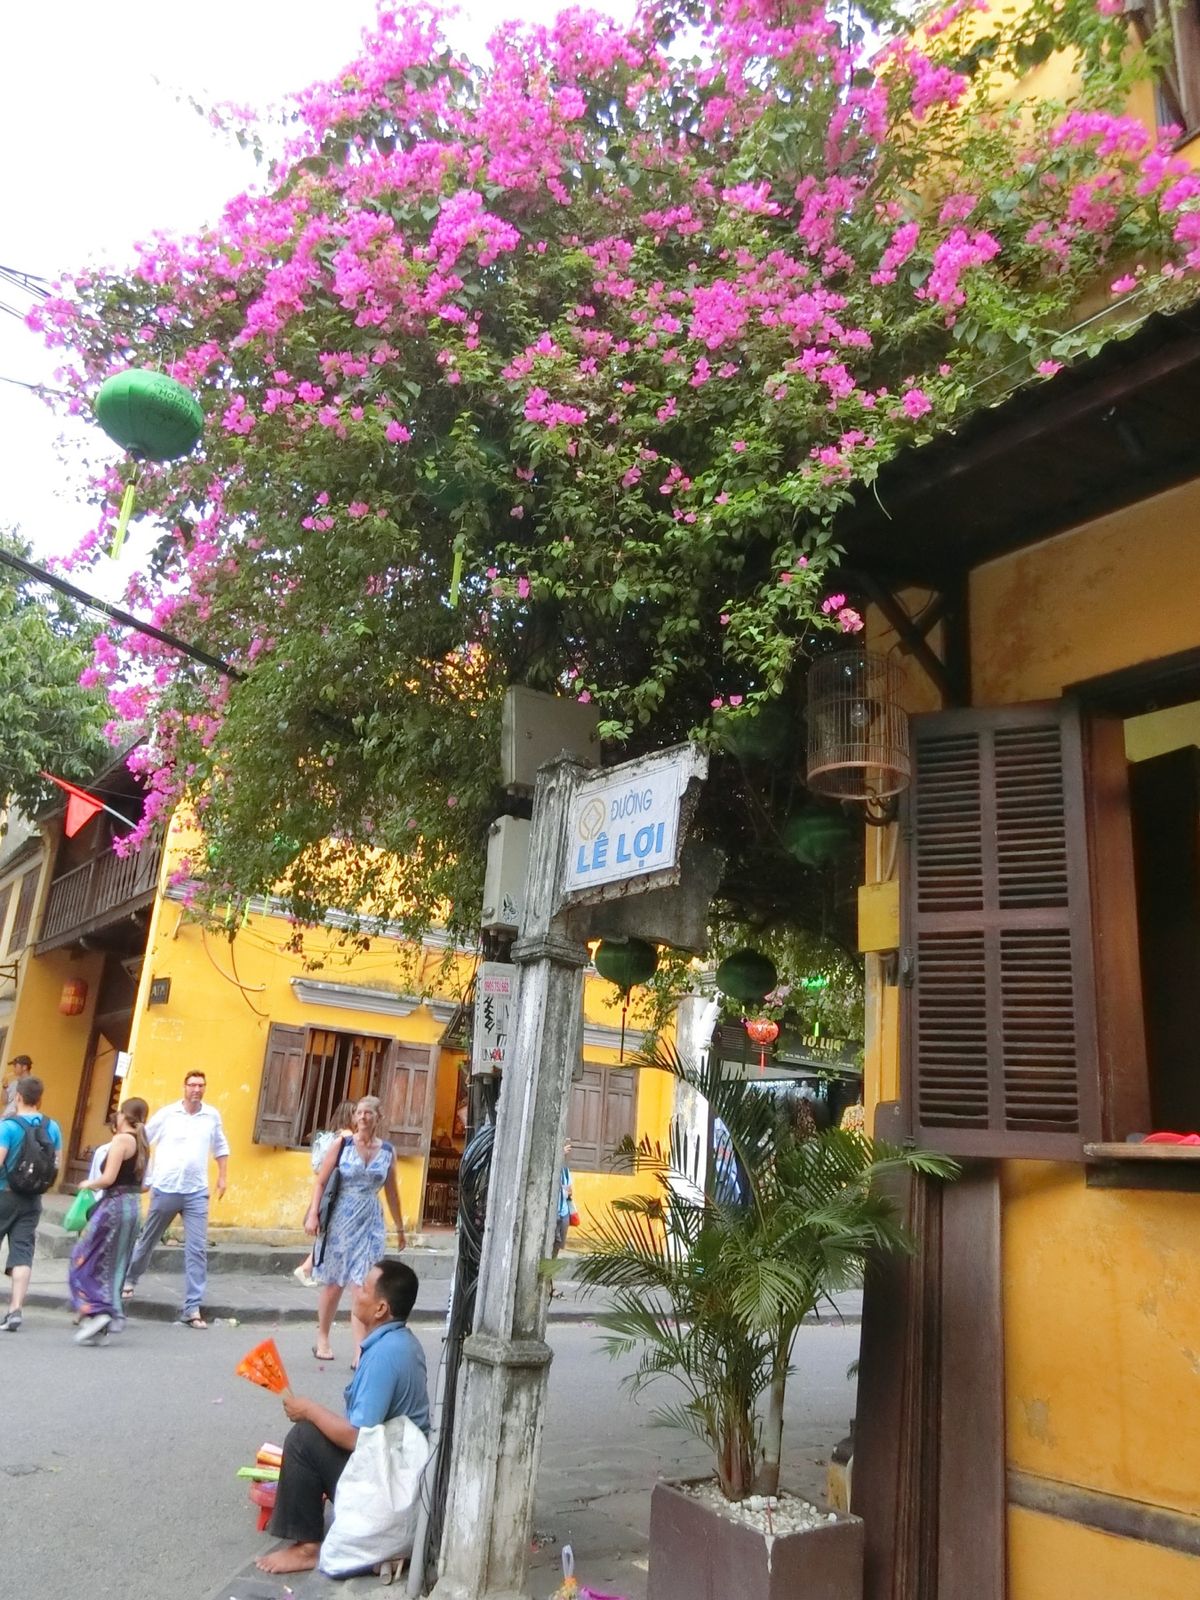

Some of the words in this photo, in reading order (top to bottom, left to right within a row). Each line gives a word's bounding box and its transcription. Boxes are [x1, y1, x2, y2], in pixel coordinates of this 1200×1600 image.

[610, 789, 652, 821] ĐƯỜNG
[576, 831, 609, 874] LÊ
[616, 822, 665, 868] LỢI
